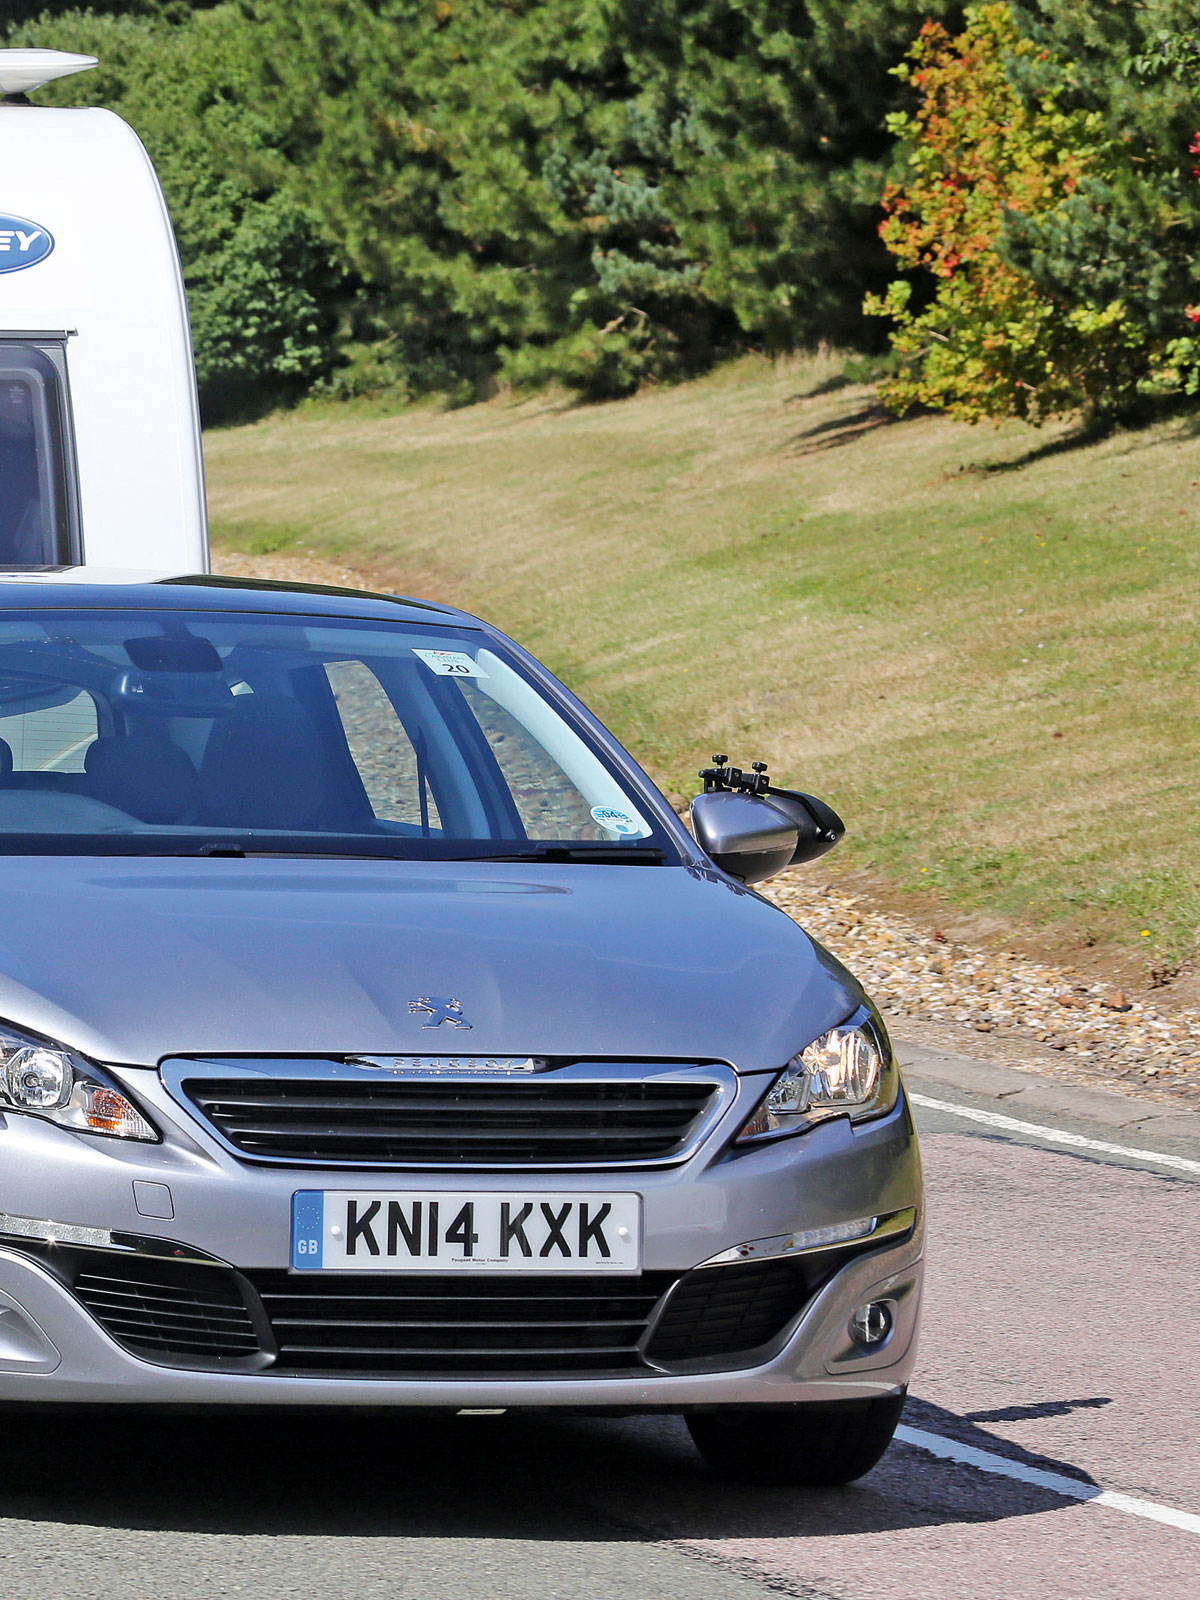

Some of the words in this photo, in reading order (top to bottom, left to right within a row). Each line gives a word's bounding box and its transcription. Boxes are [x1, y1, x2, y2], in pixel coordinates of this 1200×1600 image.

[442, 663, 470, 673] 20
[346, 1200, 479, 1257] KN14
[500, 1202, 612, 1258] KXK
[297, 1239, 319, 1255] GB
